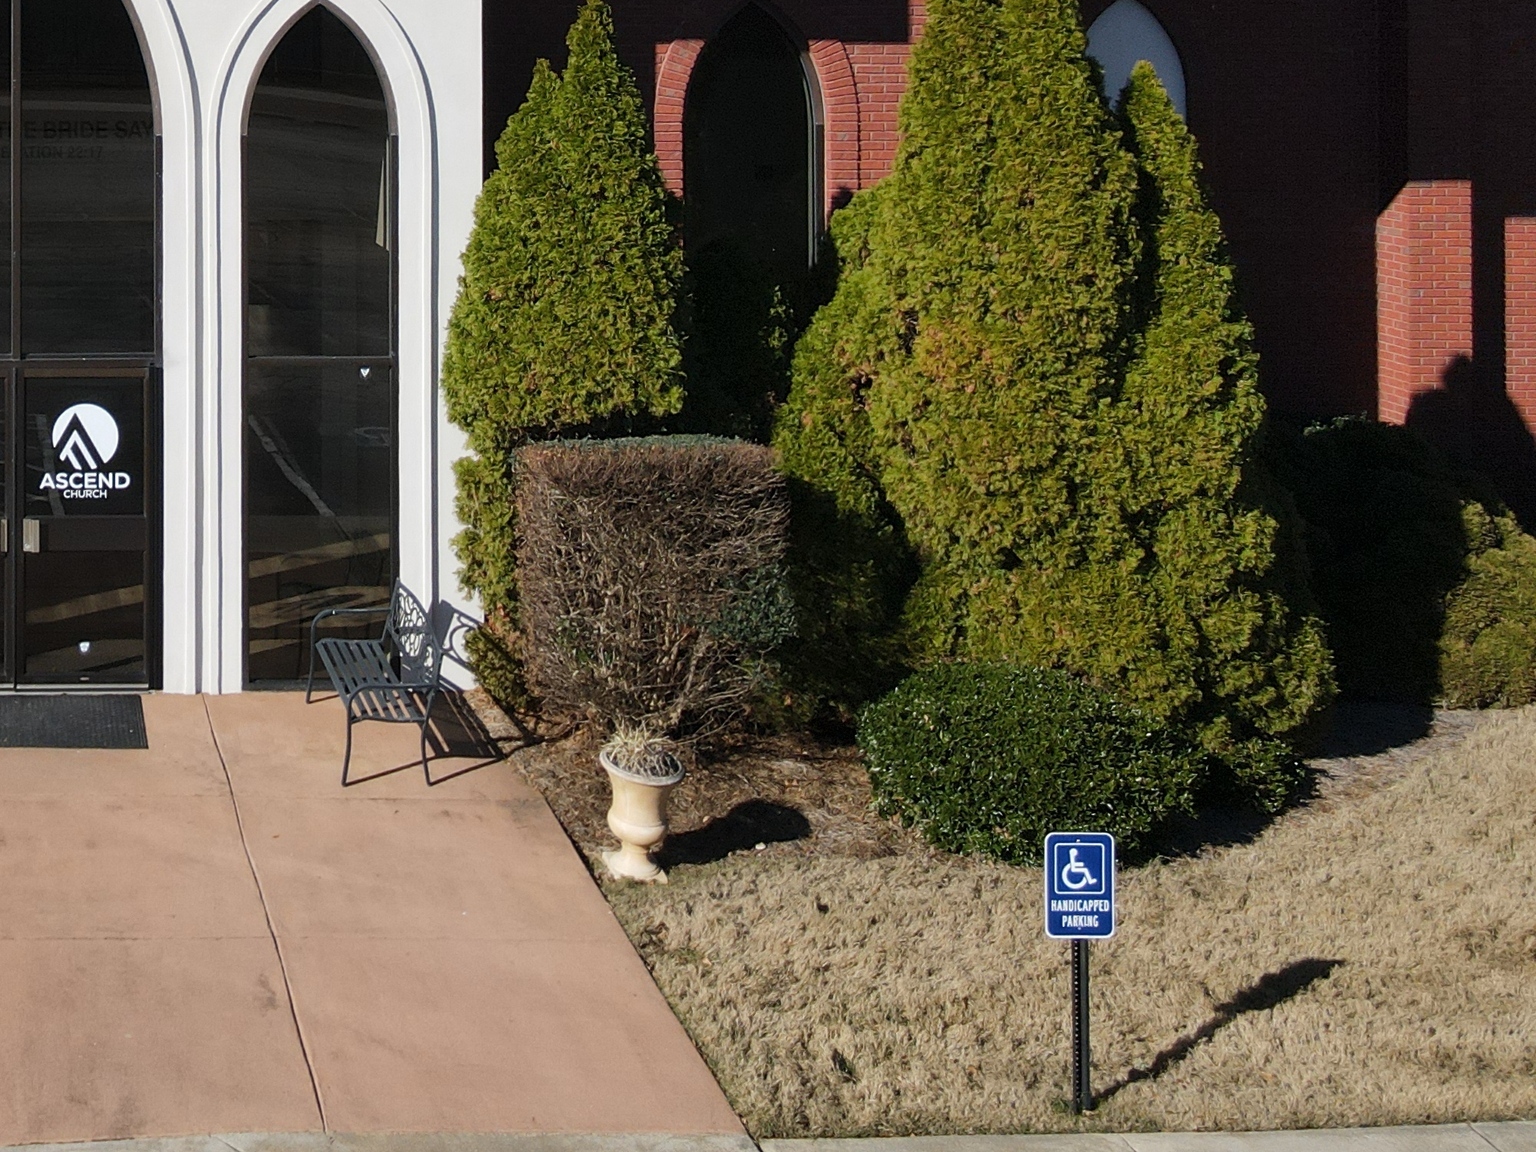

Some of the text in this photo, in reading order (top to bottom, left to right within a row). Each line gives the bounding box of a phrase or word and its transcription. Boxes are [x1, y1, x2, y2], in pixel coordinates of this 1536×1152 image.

[43, 120, 109, 139] BRIDE
[39, 472, 131, 489] ASCEND
[63, 489, 107, 499] CHURCH
[1050, 899, 1110, 912] HANDICAPPED
[1061, 915, 1099, 928] PARKING
